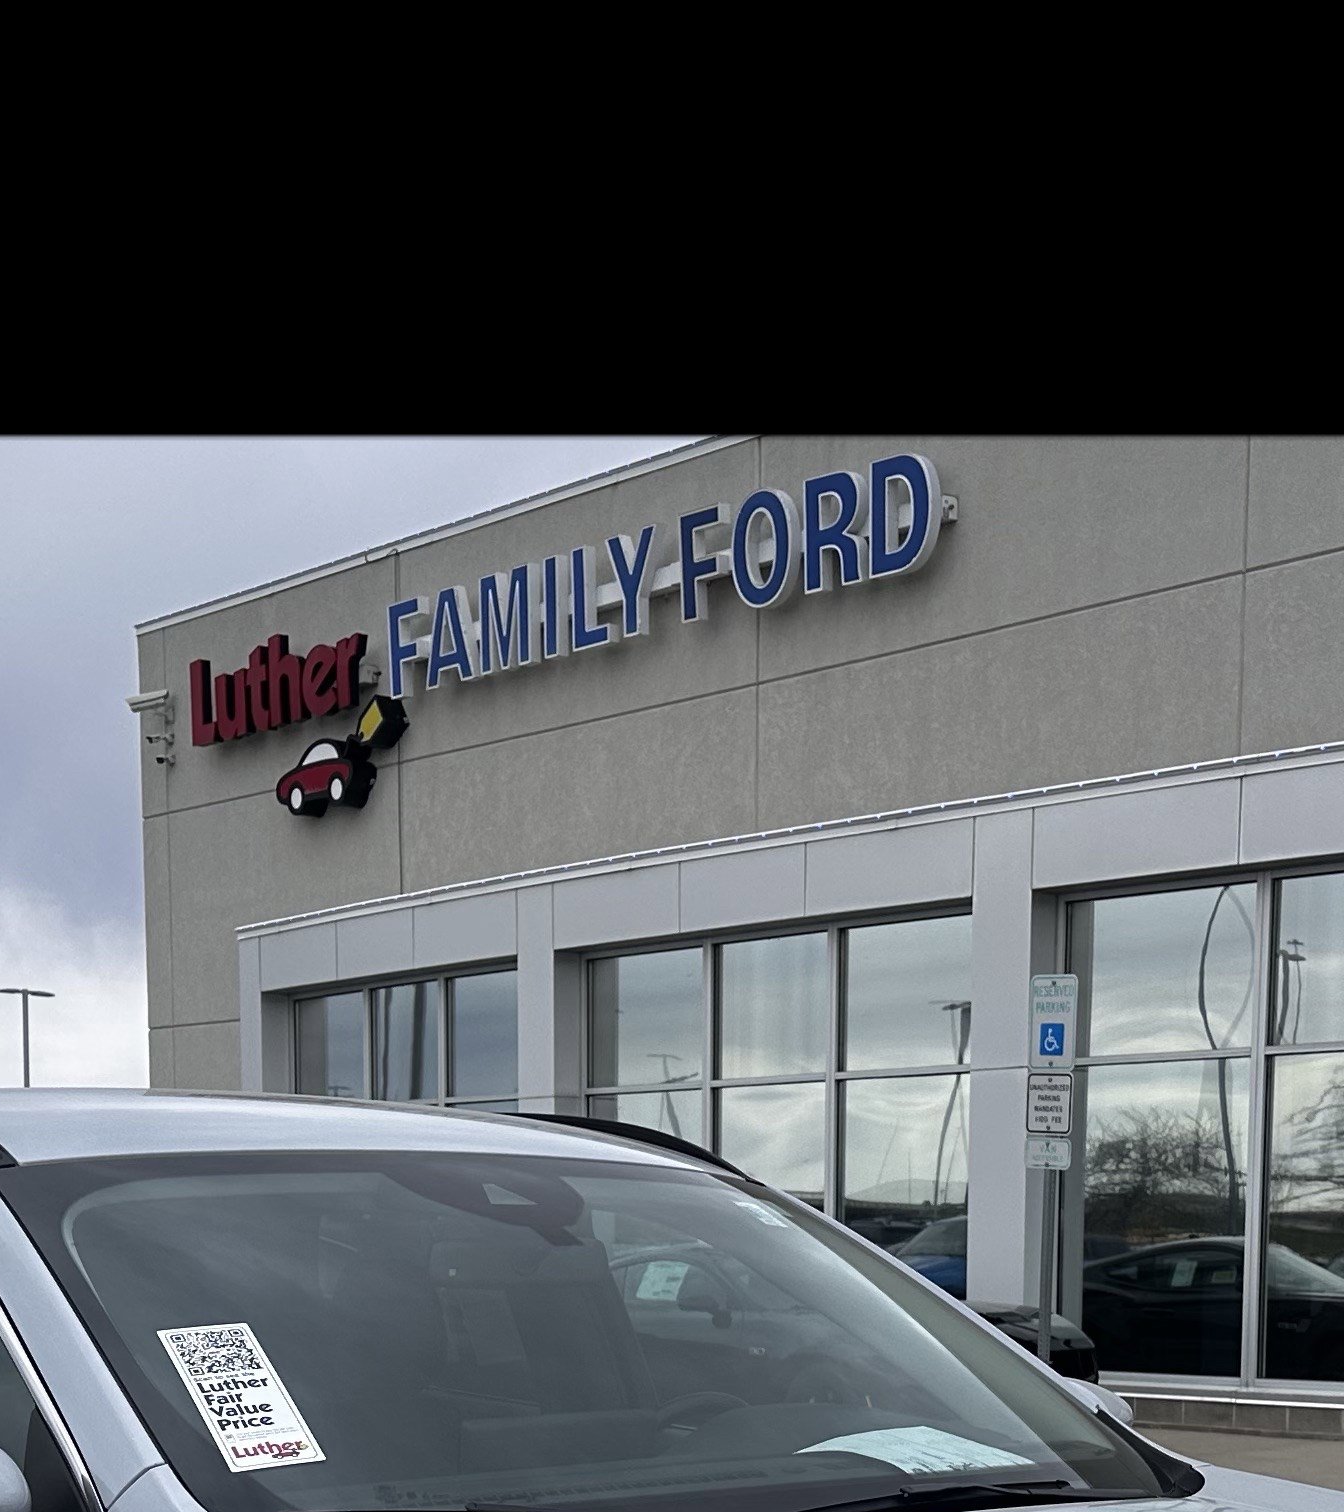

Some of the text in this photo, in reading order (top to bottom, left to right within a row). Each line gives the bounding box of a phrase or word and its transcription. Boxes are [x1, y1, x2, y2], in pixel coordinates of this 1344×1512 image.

[387, 453, 941, 700] FAMILY FORD
[189, 633, 369, 747] Luther
[196, 1377, 269, 1394] Luther
[203, 1391, 243, 1406] Fair
[209, 1403, 274, 1418] Value
[217, 1416, 275, 1432] Price
[230, 1440, 304, 1459] Luther
